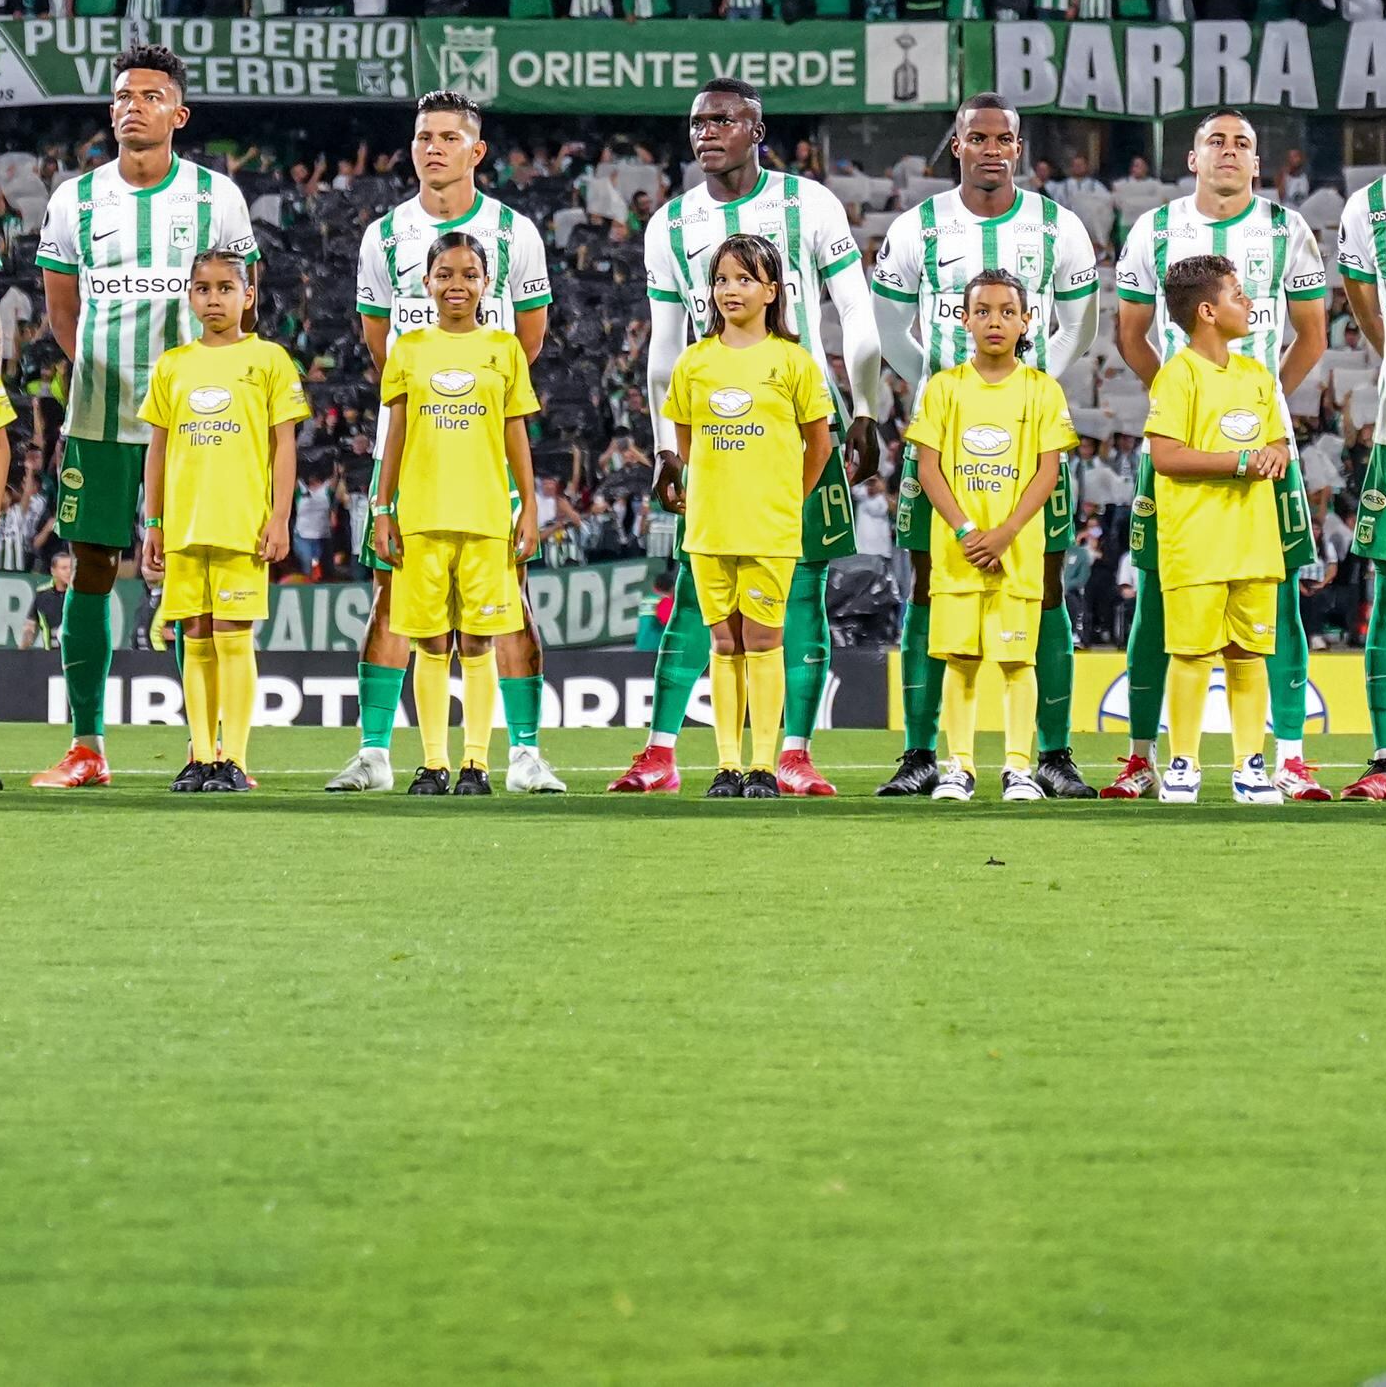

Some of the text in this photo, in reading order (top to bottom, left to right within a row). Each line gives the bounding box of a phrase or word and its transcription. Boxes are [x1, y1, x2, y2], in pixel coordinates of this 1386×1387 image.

[24, 18, 407, 60] PUERTO BERRIO
[508, 48, 856, 89] ORIENTE VERDE
[995, 20, 1319, 117] BARRA
[419, 401, 488, 417] mercado
[178, 418, 241, 434] mercado
[435, 416, 470, 430] libre
[701, 422, 765, 437] mercado
[190, 432, 223, 447] libre
[712, 436, 746, 451] libre
[954, 462, 1020, 480] mercado
[966, 476, 1002, 493] libre
[819, 483, 851, 528] 19
[1279, 490, 1307, 534] 13
